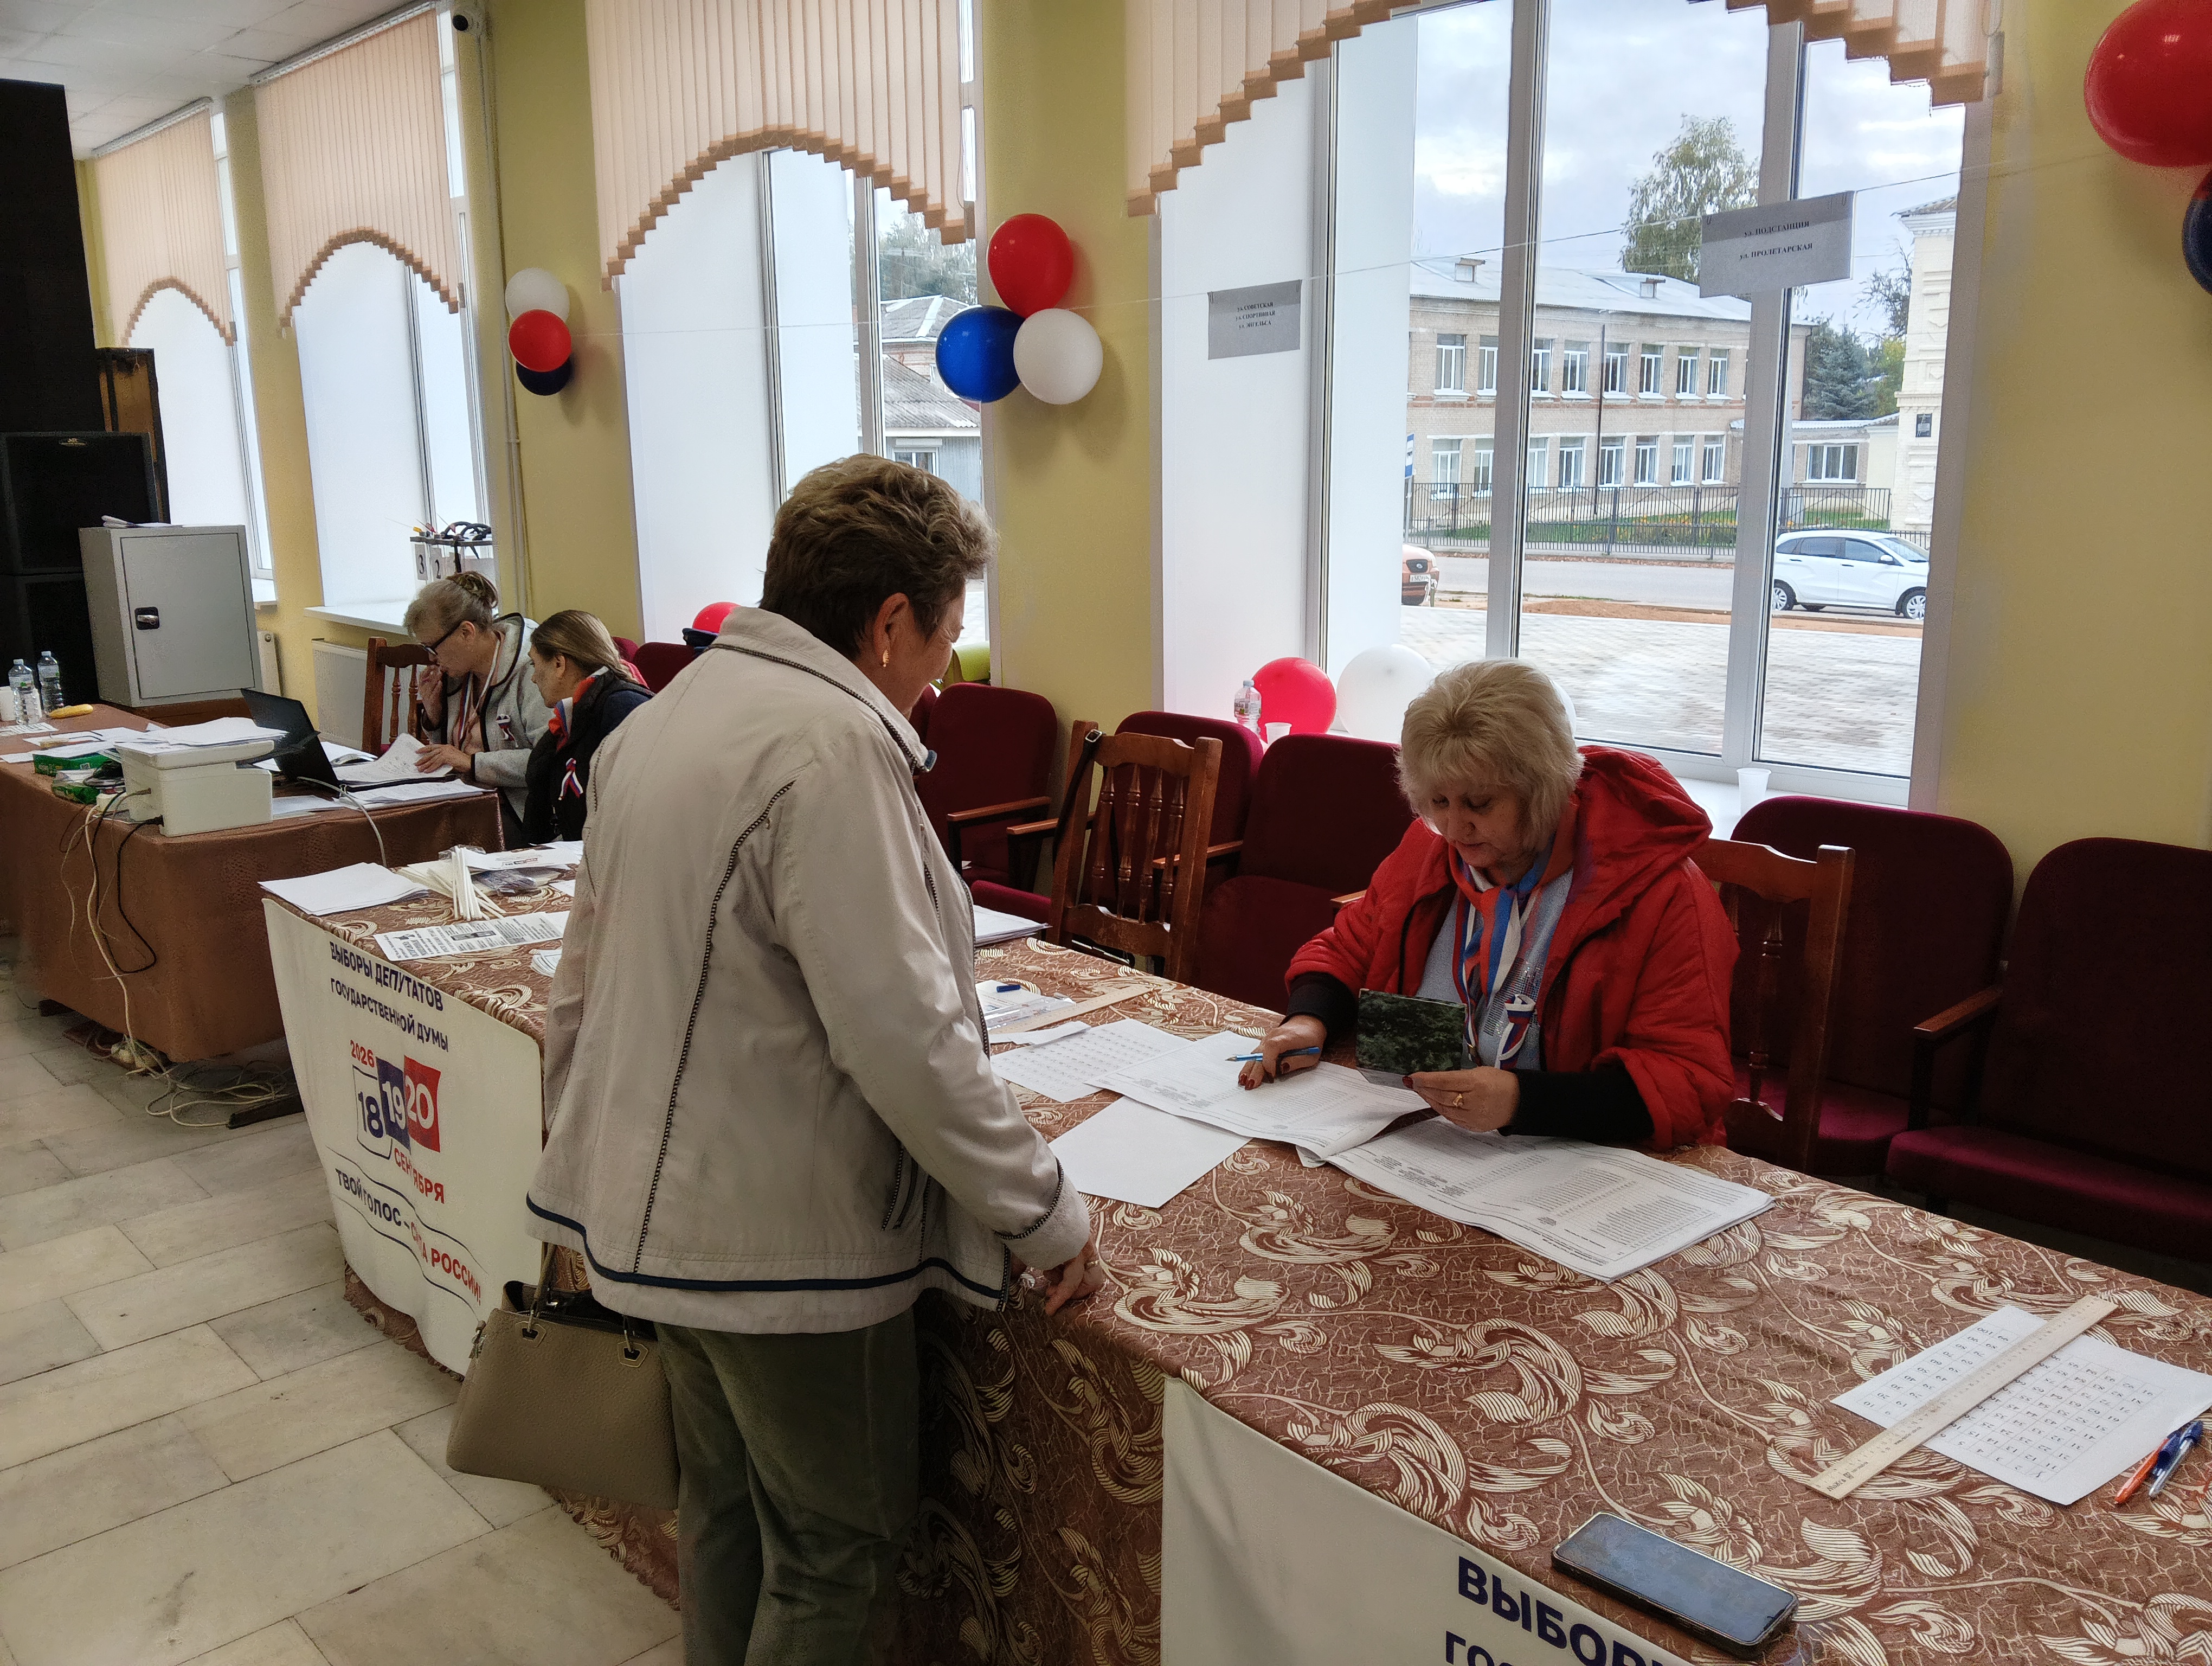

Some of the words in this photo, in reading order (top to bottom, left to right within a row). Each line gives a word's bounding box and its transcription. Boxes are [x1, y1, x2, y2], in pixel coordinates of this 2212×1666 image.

[1756, 221, 1809, 235] ПОДСТАНЦИЯ
[1751, 242, 1812, 258] ПРОЛЕТАРСКАЯ
[1243, 310, 1275, 319] СПОРТИВНАЯ
[1244, 302, 1273, 310] СОВЕТСКАЯ
[419, 554, 425, 574] 3
[435, 559, 441, 579] 2
[330, 941, 373, 979] ВЫБОРЫ
[375, 963, 443, 1011] ДЕПУТАТОВ
[331, 978, 415, 1035] ГОСУДАРСТВЕННОЙ
[417, 1022, 448, 1052] ДУМЫ
[350, 1040, 375, 1068] 2026
[358, 1091, 383, 1138] 18
[382, 1081, 406, 1130] 19
[405, 1075, 434, 1129] 20
[394, 1148, 445, 1204] СЕНЯБРЯ
[335, 1168, 363, 1201] ТВОЙ
[363, 1188, 401, 1226] ГОЛОС
[431, 1248, 481, 1306] РОССИИ!
[1458, 1556, 1663, 1666] ВЫБОР
[1446, 1630, 1513, 1666] ГО
